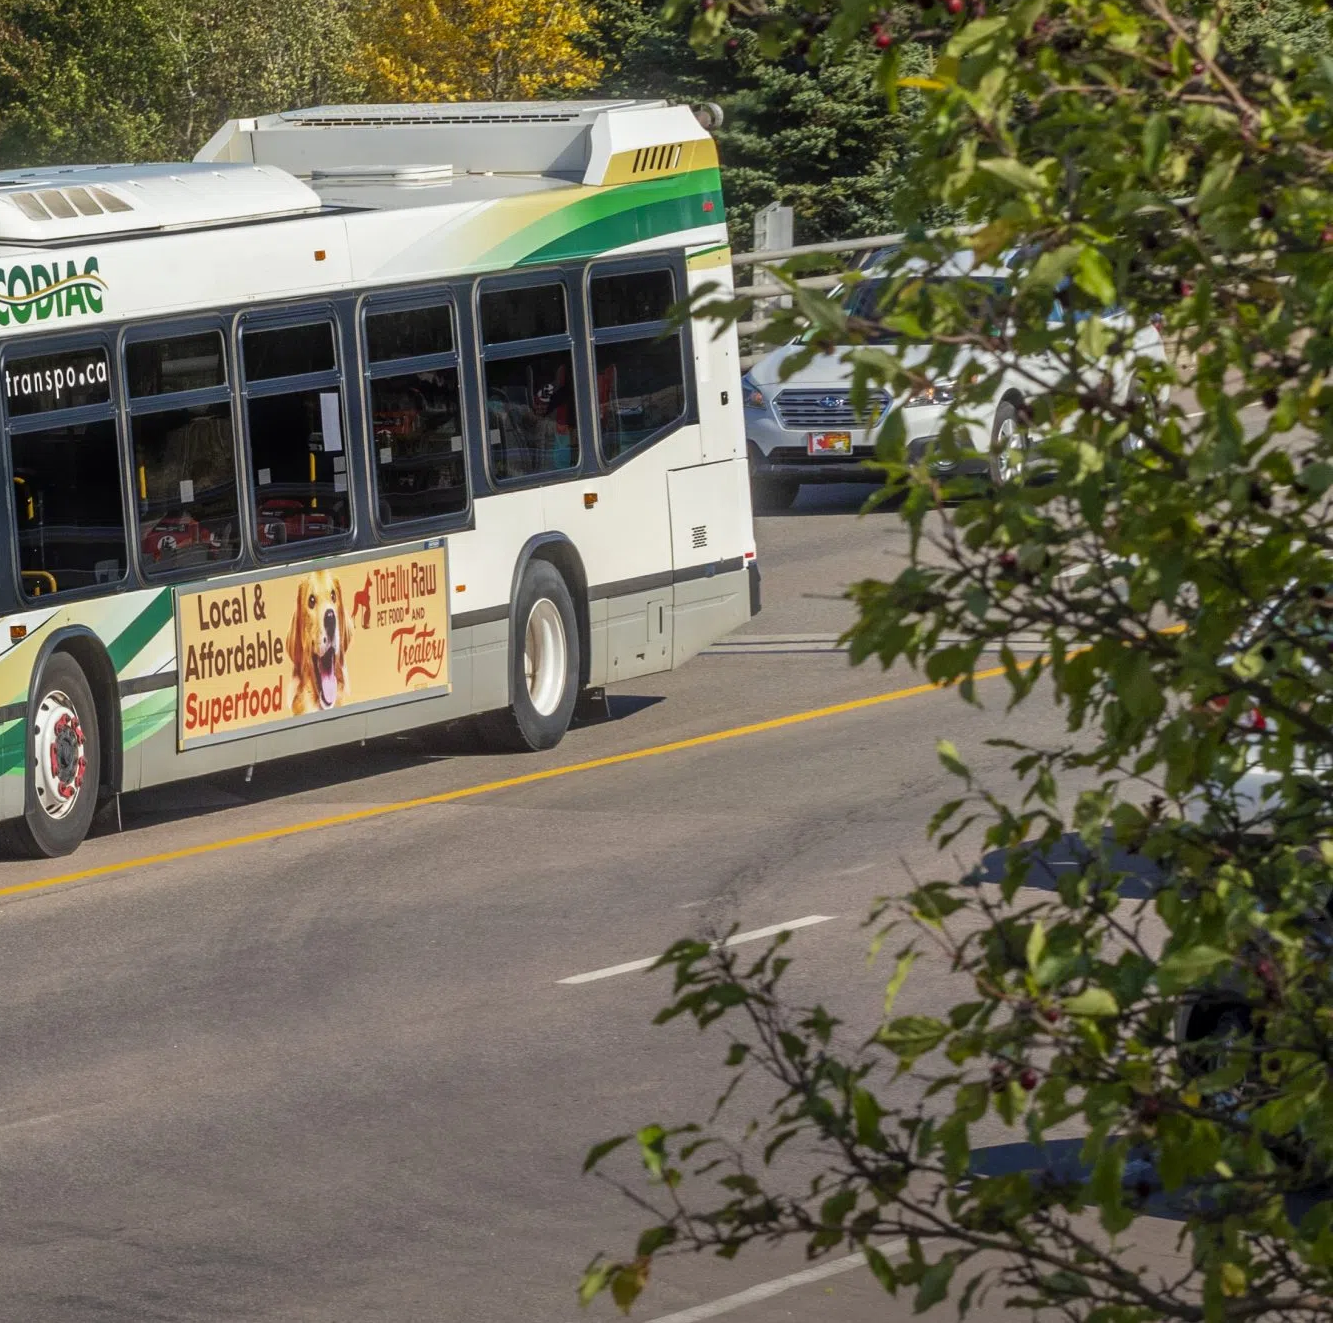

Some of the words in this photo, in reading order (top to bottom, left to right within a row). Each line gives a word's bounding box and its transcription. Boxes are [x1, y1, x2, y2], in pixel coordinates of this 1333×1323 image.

[5, 361, 107, 400] transpo.ca
[197, 586, 249, 631] Local
[253, 583, 267, 621] &
[373, 564, 410, 616] Totally
[411, 562, 437, 598] Raw
[376, 610, 388, 627] PET
[389, 607, 404, 625] FOOD
[411, 607, 425, 621] AND
[184, 630, 284, 682] Affordable
[390, 622, 445, 686] Treatery
[185, 675, 283, 734] Superfood
